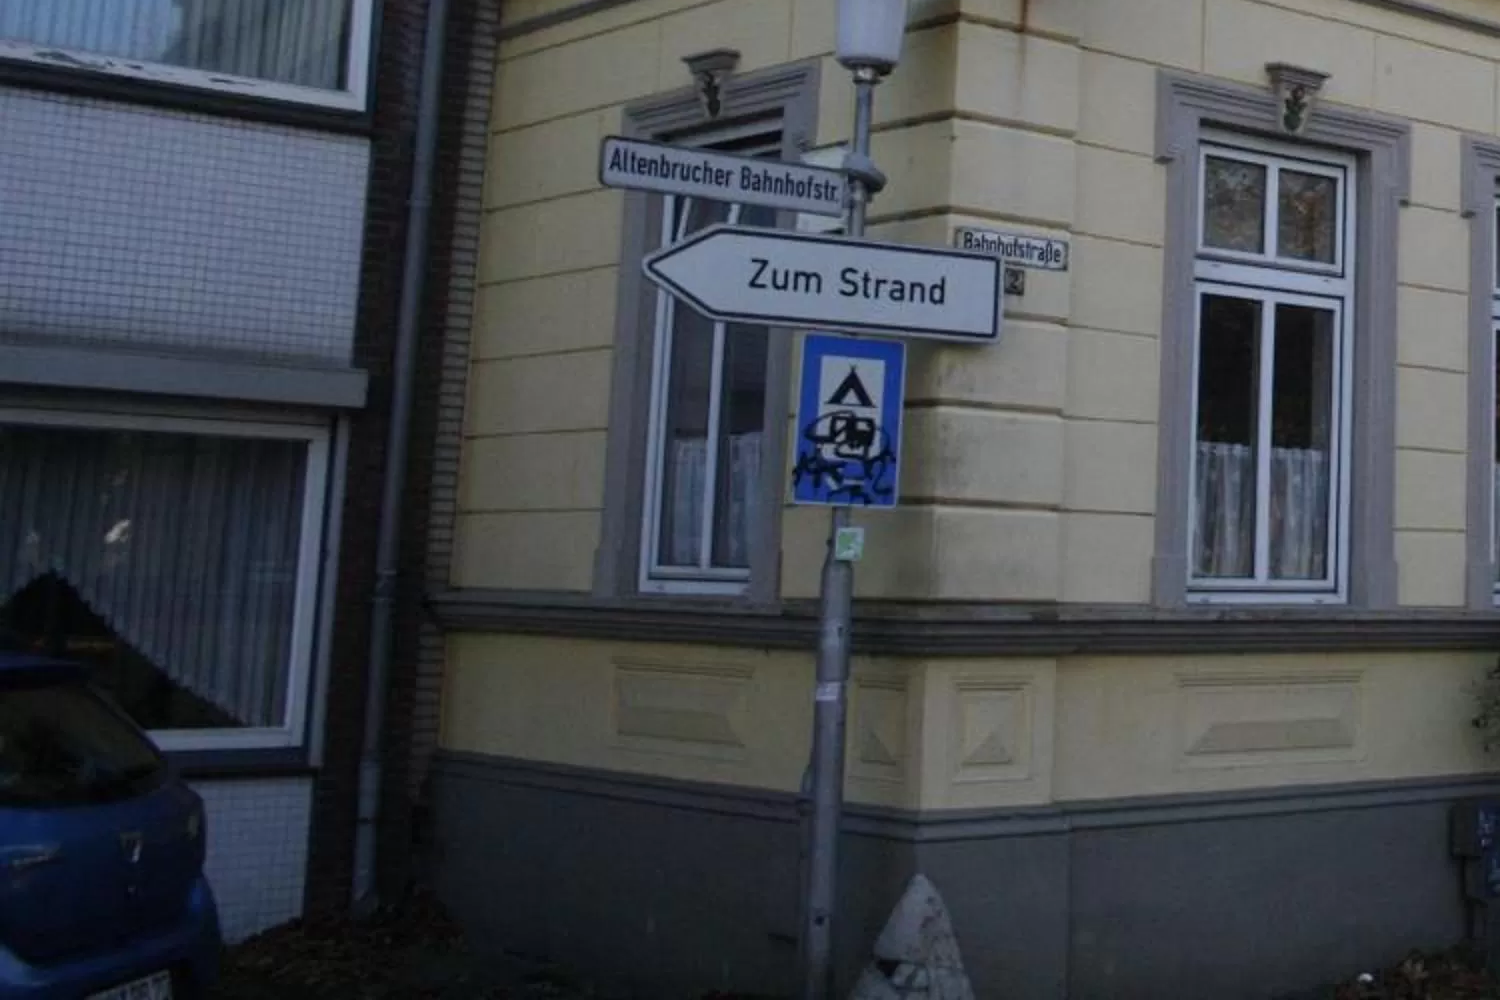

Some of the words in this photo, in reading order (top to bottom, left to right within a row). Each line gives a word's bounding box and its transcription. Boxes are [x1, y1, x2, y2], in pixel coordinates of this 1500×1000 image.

[609, 146, 736, 188] Altenbrucher
[739, 165, 840, 203] Bahnhofstr.
[963, 231, 1062, 264] Bahnhofstraße
[748, 259, 822, 295] Zum
[838, 267, 947, 305] Strand
